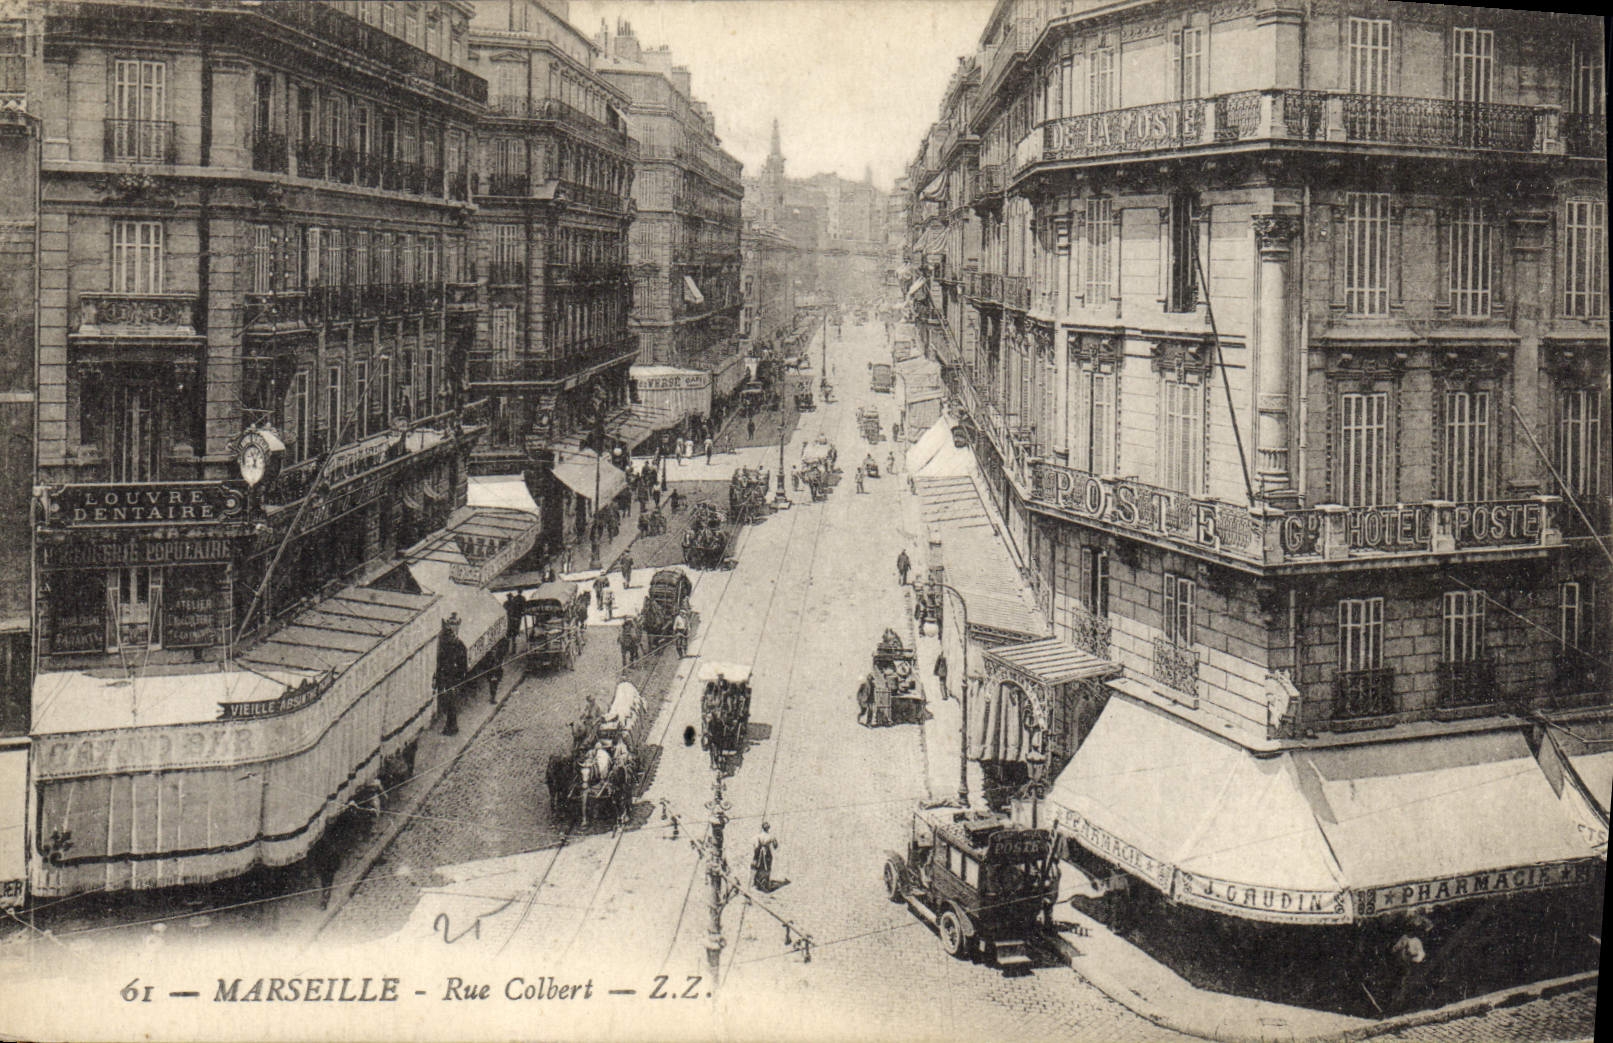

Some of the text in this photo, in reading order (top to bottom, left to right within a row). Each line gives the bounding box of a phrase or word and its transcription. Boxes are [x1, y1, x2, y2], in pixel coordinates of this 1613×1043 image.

[1119, 98, 1198, 144] POSTE
[73, 505, 215, 522] DENTAIRE
[86, 491, 205, 505] LOUVRE
[1053, 470, 1220, 552] POSTE
[1454, 503, 1541, 542] POSTE
[145, 539, 232, 562] POPULAIRE
[230, 702, 275, 716] VIEILLE
[1065, 811, 1141, 868] PHARMACIE
[1401, 866, 1550, 904] PHARMACIE
